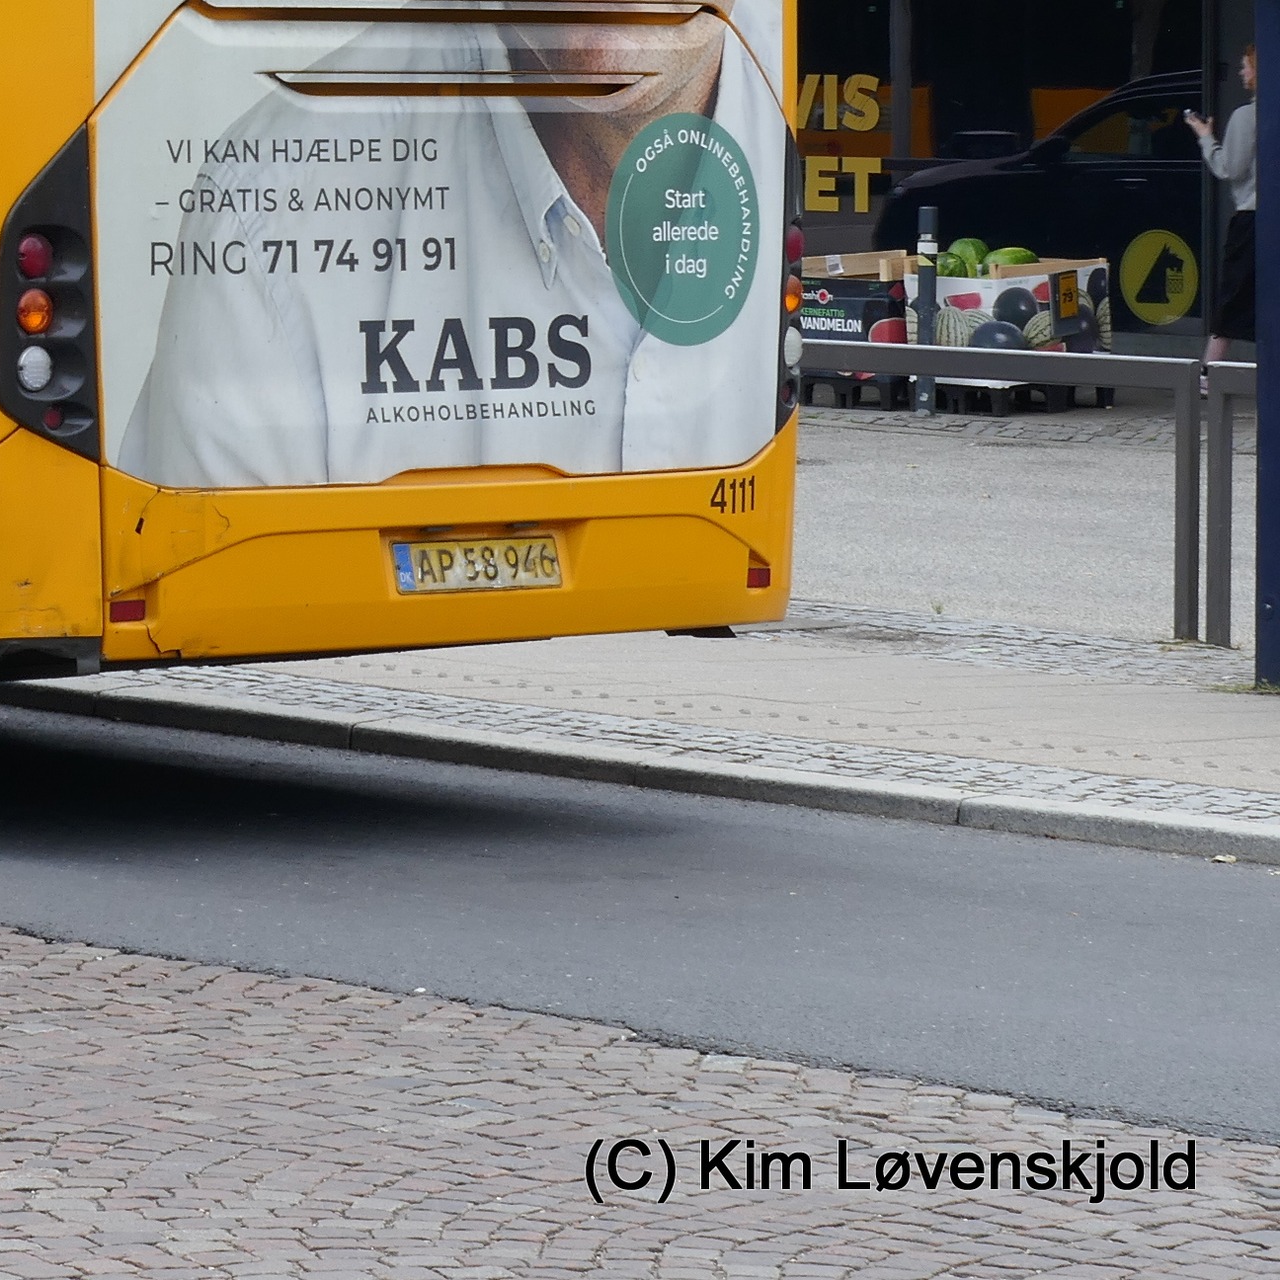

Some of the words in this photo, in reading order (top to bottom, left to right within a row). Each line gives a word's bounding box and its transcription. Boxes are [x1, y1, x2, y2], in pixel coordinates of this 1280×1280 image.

[166, 139, 193, 163] VI
[204, 138, 261, 164] KAN
[271, 138, 383, 163] HJÆLPE
[392, 138, 438, 163] DIG
[178, 188, 279, 214] GRATIS
[287, 188, 305, 213] &
[314, 186, 450, 212] ANONYMT
[664, 189, 706, 209] Start
[635, 129, 674, 173] OGSÅ
[678, 129, 752, 300] ONLINEBEHANDLING
[652, 221, 719, 242] allerede
[149, 240, 248, 277] RING
[262, 239, 299, 275] 71
[313, 238, 359, 274] 74
[371, 238, 408, 273] 91
[422, 237, 457, 271] 91
[665, 254, 670, 274] i
[674, 254, 707, 278] dag
[800, 316, 862, 333] VANDMELON
[359, 314, 593, 395] KABS
[366, 400, 596, 425] ALKOHOLBEHANDLING
[710, 476, 756, 514] 4111
[400, 572, 413, 583] DK
[419, 548, 454, 584] AP
[463, 546, 498, 581] 58
